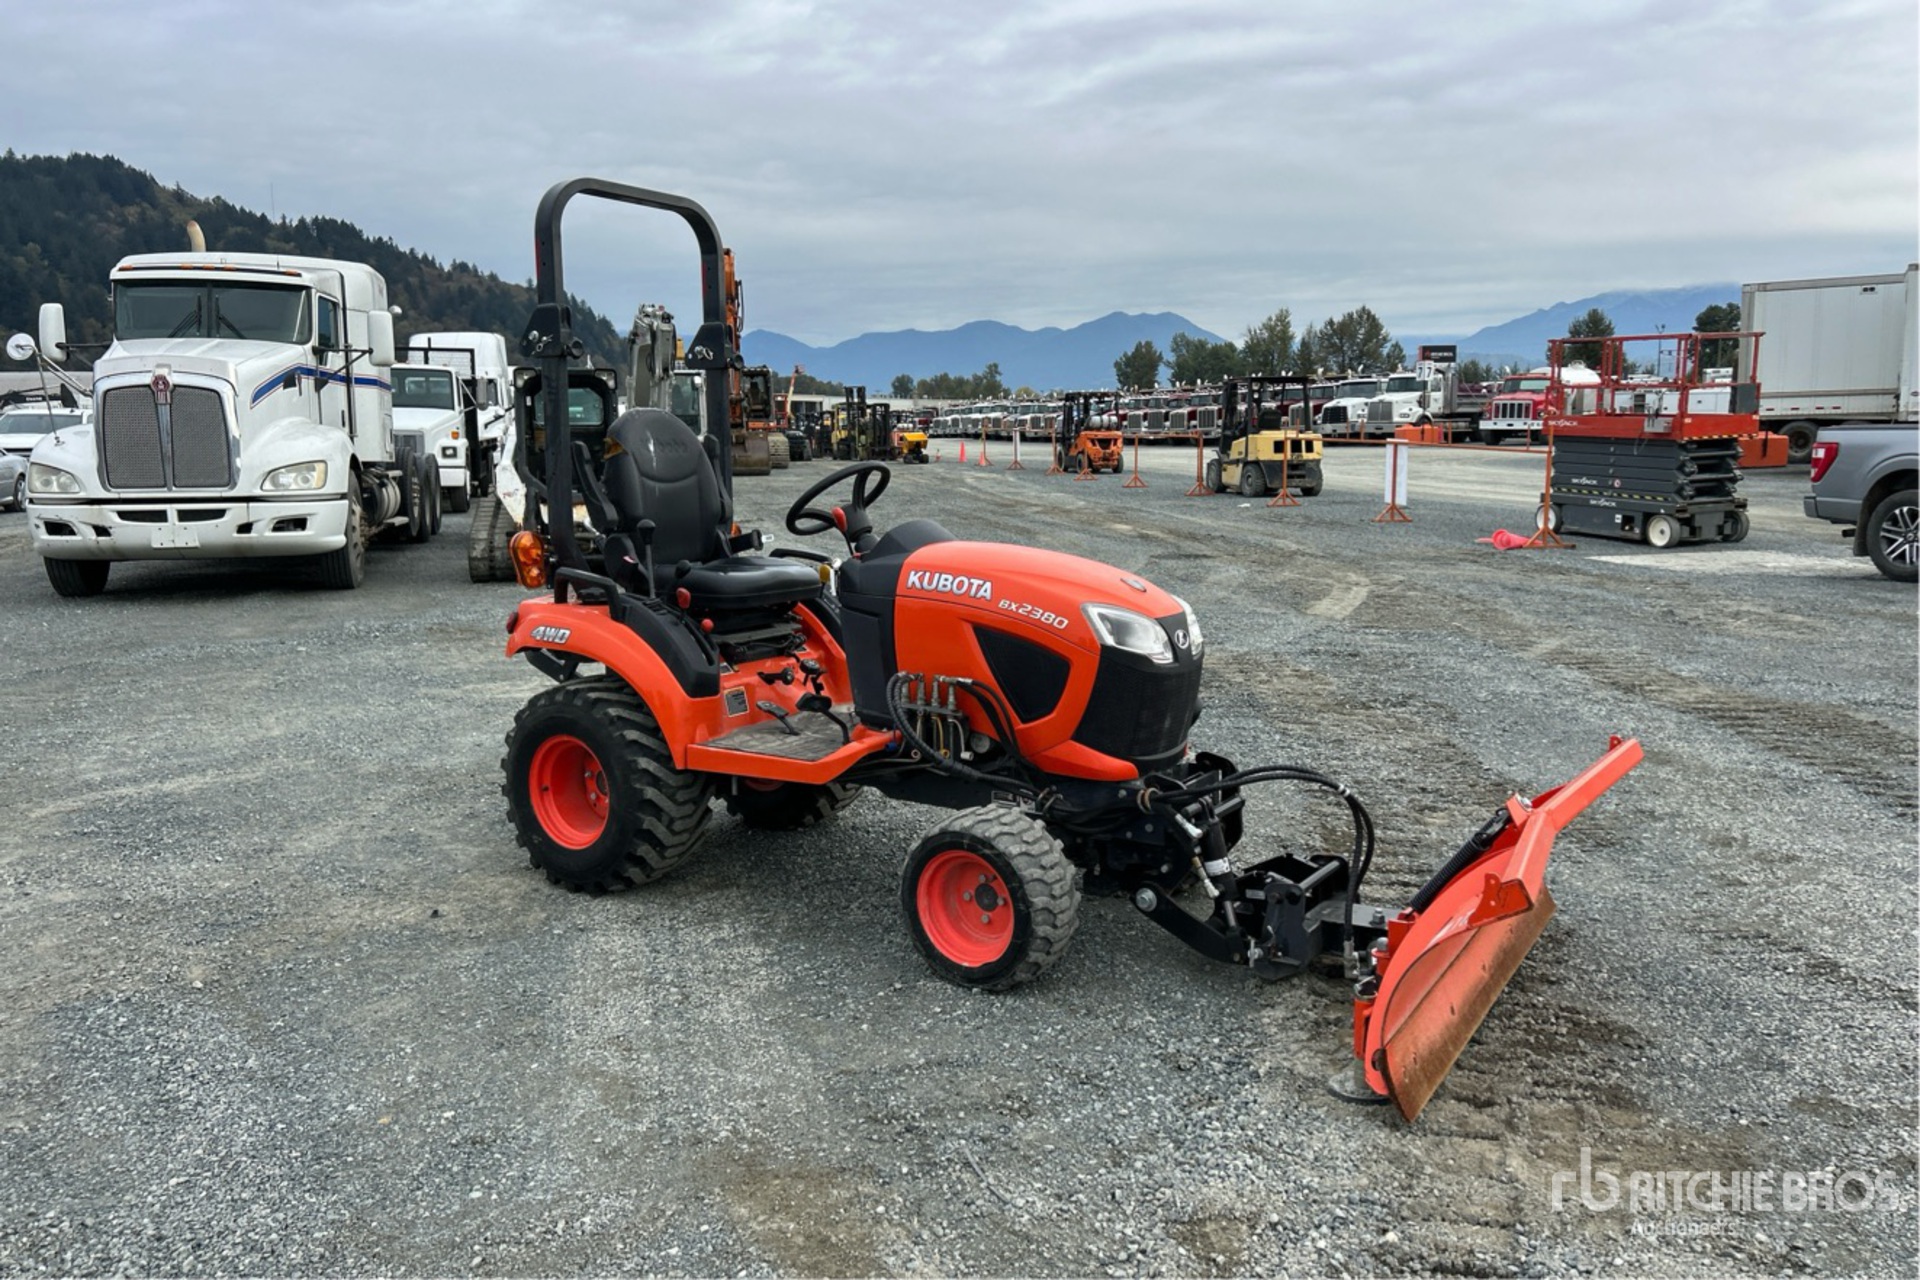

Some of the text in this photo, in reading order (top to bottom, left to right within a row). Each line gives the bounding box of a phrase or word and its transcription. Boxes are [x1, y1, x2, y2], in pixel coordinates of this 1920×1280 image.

[907, 570, 993, 600] KUBOTA
[998, 599, 1069, 630] BX2380
[530, 625, 571, 644] 4WD
